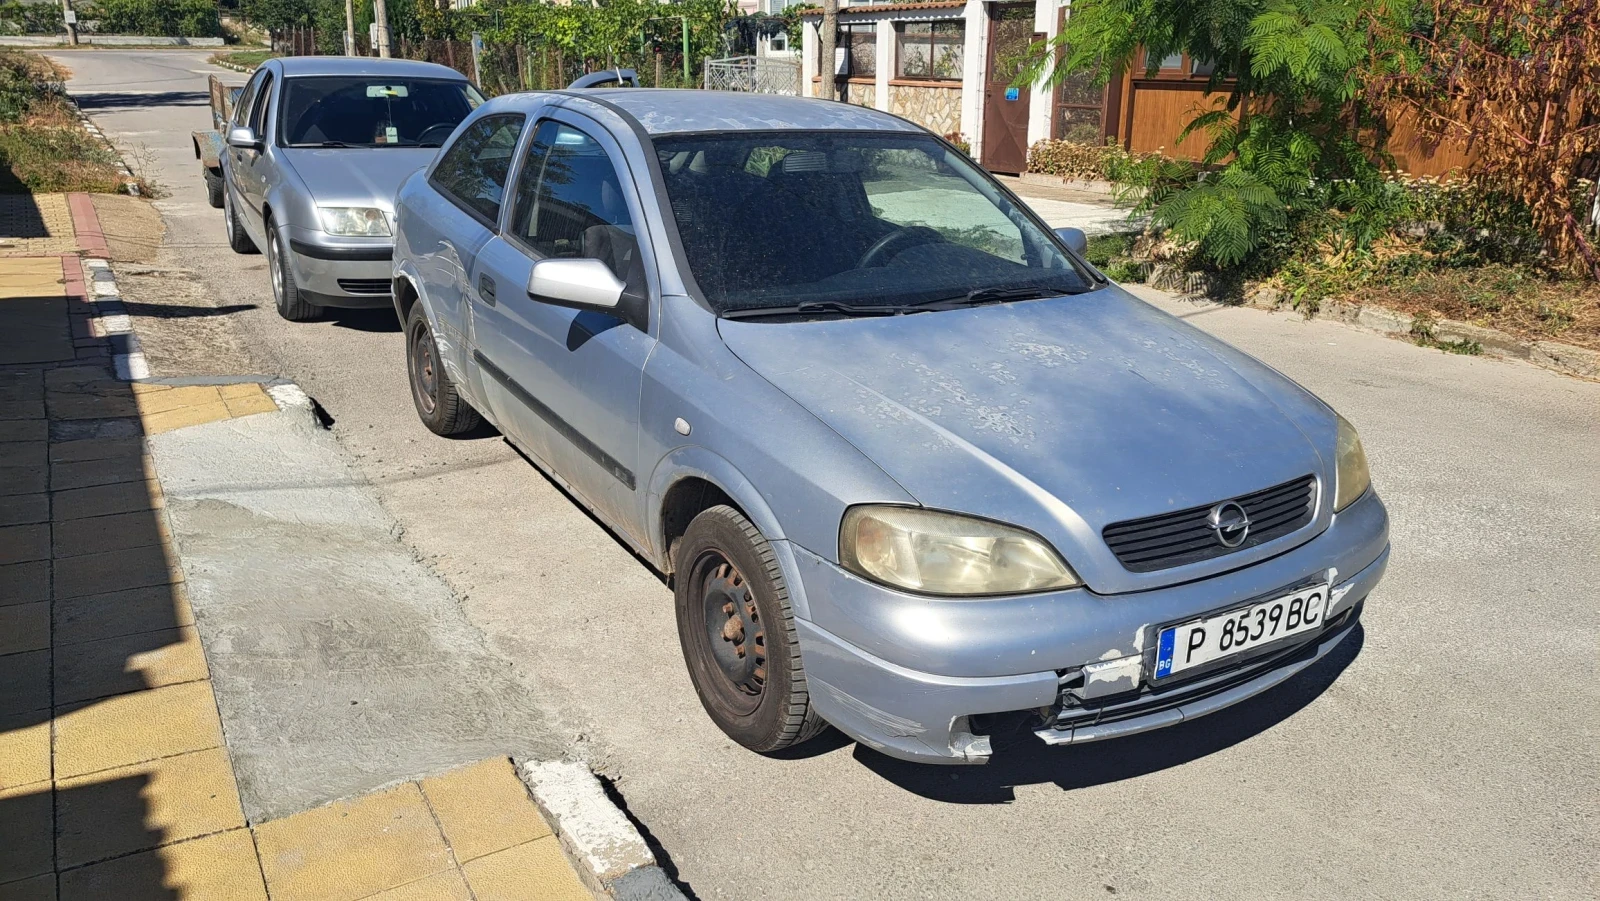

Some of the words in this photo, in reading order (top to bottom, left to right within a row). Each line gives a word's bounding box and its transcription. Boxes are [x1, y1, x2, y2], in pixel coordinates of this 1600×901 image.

[1186, 628, 1206, 664] P
[1219, 604, 1283, 651] 8539
[1286, 592, 1322, 632] BC
[1158, 658, 1172, 671] BG
